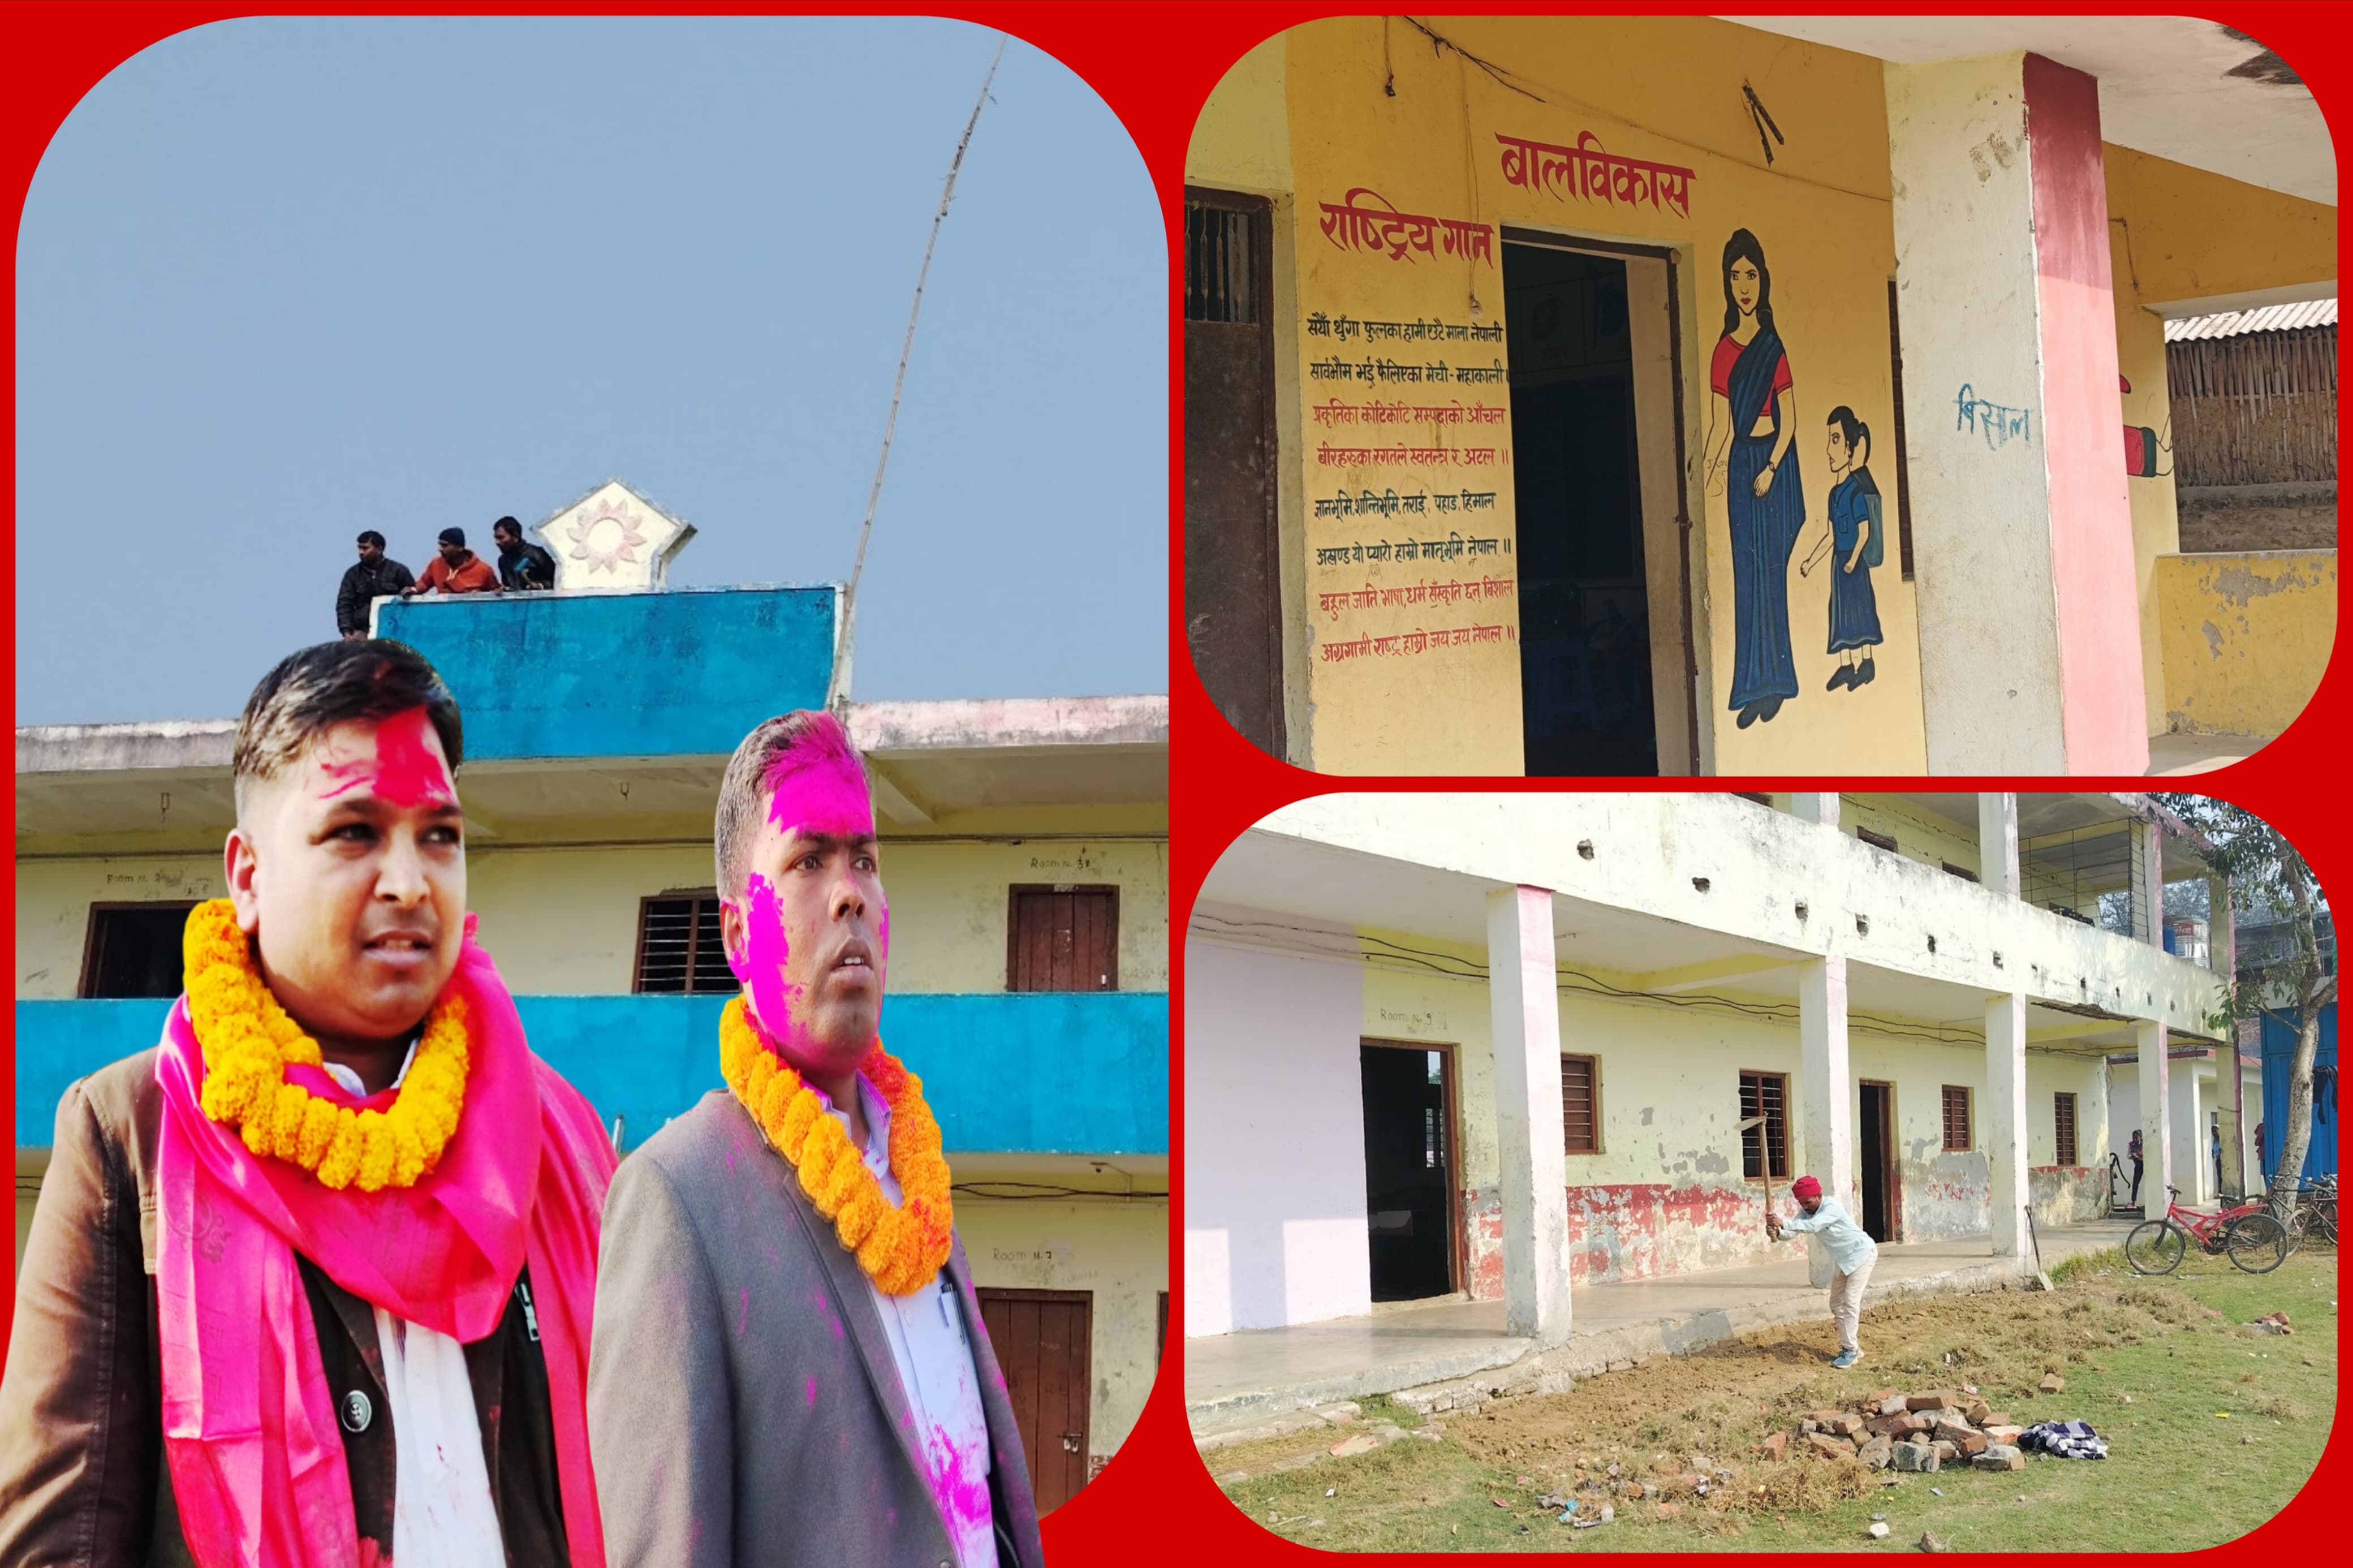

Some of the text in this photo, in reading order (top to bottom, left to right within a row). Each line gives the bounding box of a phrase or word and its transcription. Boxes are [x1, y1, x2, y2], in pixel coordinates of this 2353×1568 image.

[1494, 130, 1696, 219] बालविकास
[1318, 187, 1495, 269] राष्ट्रिय गान
[1363, 320, 1402, 343] फुलका
[1403, 318, 1426, 342] हामी
[1446, 324, 1468, 342] माला
[1471, 321, 1503, 343] नेपाली
[1376, 357, 1423, 384] फैलिएका
[1425, 360, 1448, 383] मेची
[1313, 398, 1359, 428] प्रकृतिका
[1467, 400, 1506, 424] आँचल
[1373, 442, 1408, 466] रगतले
[1451, 449, 1463, 467] र
[1464, 448, 1496, 466] अटल
[1461, 489, 1496, 512] हिमाल
[1316, 546, 1352, 566] अखण्ड
[1353, 542, 1364, 563] यो
[1365, 540, 1392, 562] प्यारो
[1394, 537, 1419, 562] हाम्रो
[1421, 531, 1464, 564] मातृभूमि
[1468, 536, 1498, 557] नेपाल
[1319, 592, 1350, 621] बहुल
[1405, 578, 1429, 604] धर्म
[1482, 575, 1514, 598] बिशाल
[1403, 628, 1427, 655] हाम्रो
[1429, 632, 1450, 648] जय
[1451, 629, 1471, 647] जय
[1472, 623, 1502, 643] नेपाल
